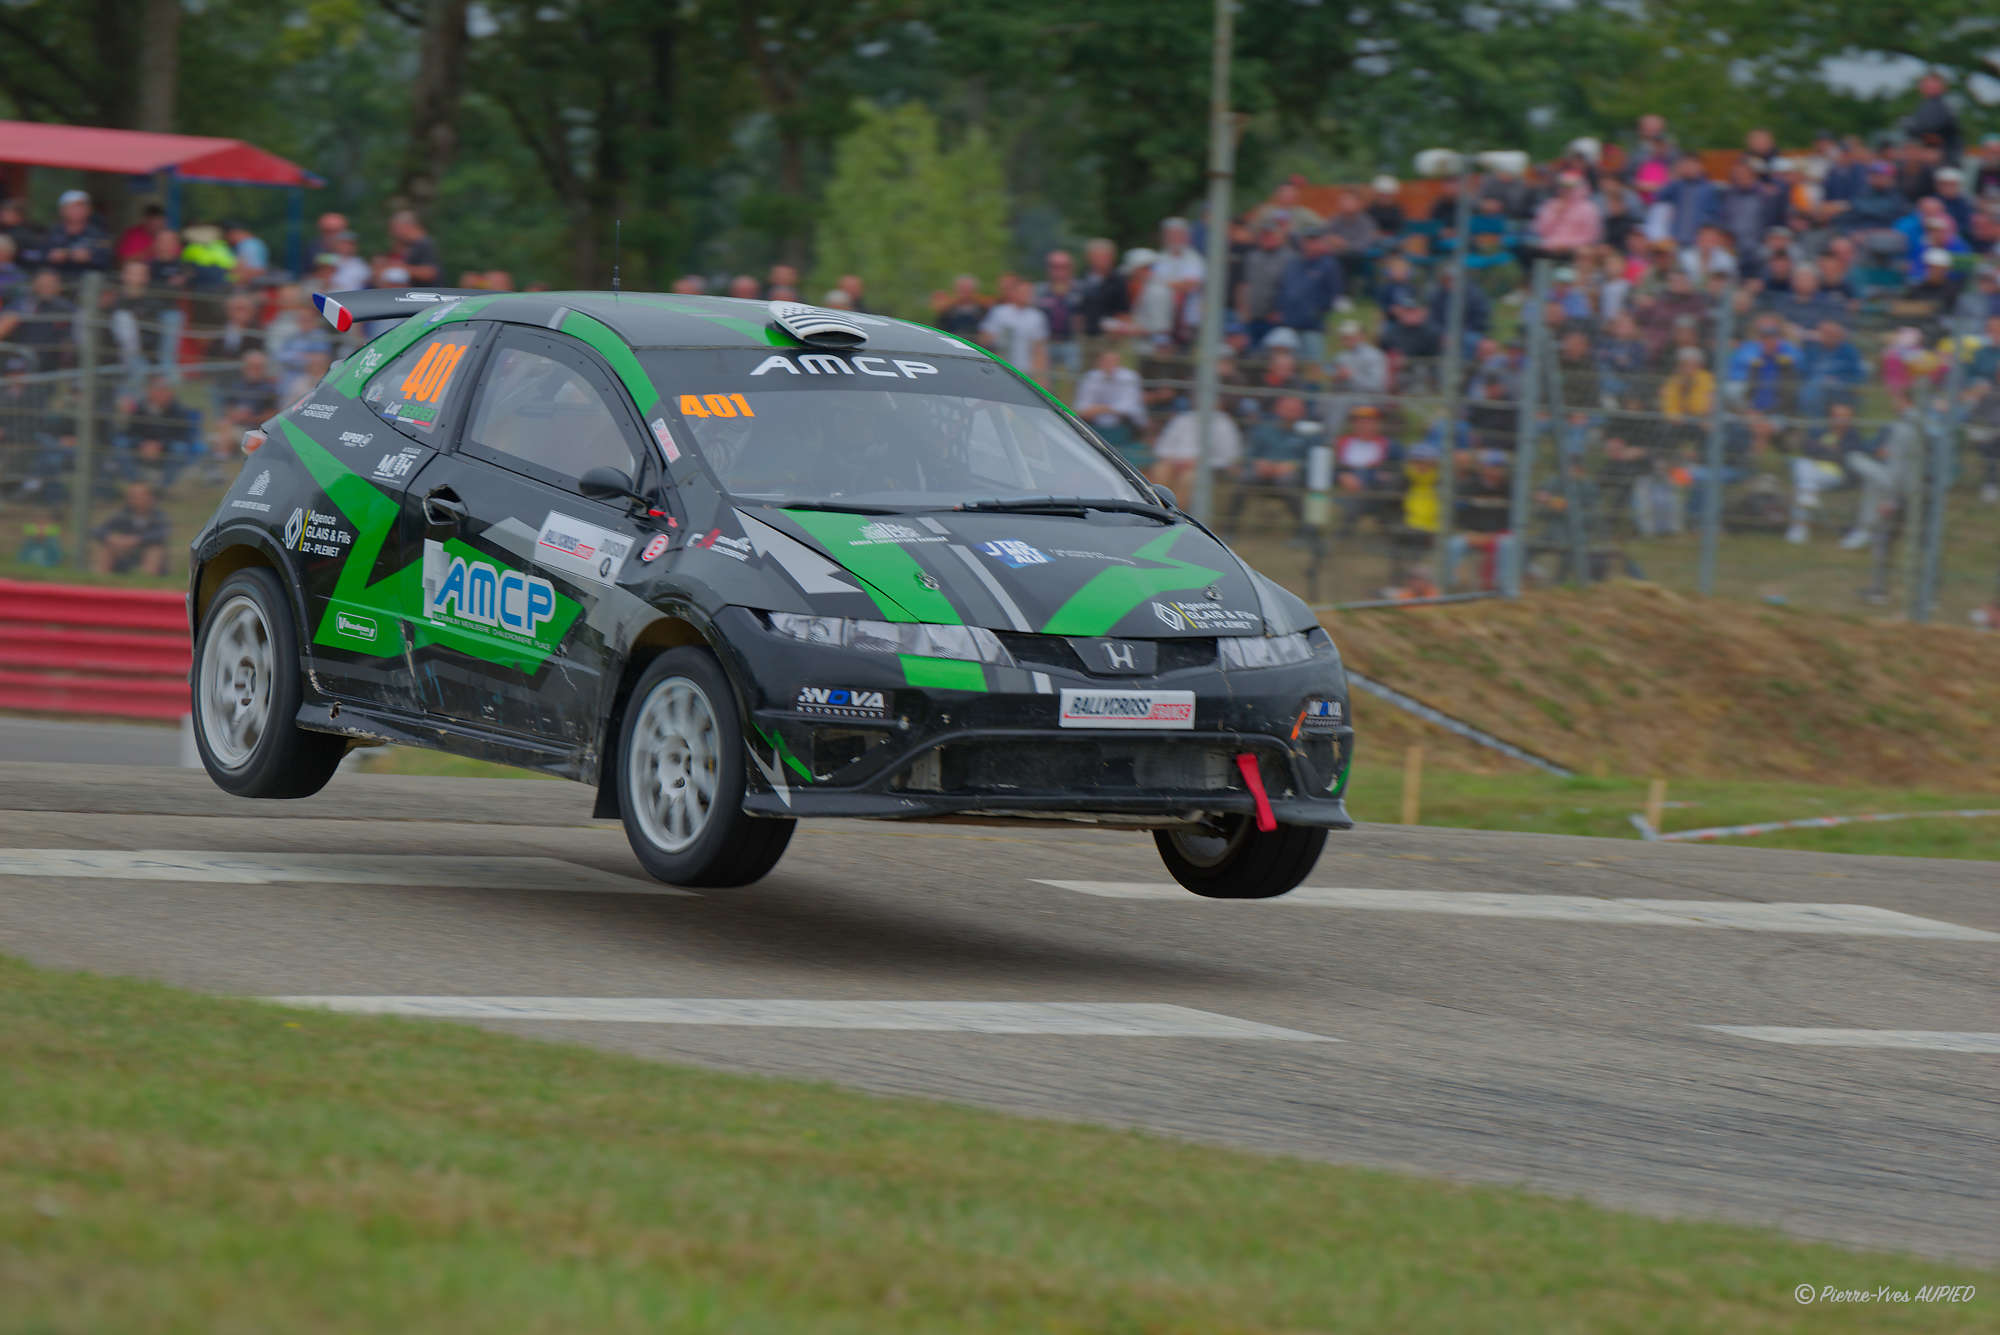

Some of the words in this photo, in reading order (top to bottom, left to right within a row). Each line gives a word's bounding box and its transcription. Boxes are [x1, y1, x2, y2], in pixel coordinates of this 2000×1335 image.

[400, 342, 467, 403] 401
[750, 354, 939, 379] AMCP
[680, 393, 756, 418] 401
[308, 510, 336, 525] Agence
[305, 526, 330, 541] GLAIS
[330, 531, 336, 542] &
[336, 530, 351, 545] Fils
[302, 542, 311, 552] 22
[433, 559, 554, 634] AMCP
[1184, 610, 1227, 620] GLAIS
[796, 705, 885, 718] MOTORSPORT
[1070, 696, 1152, 716] RALLYCROSS
